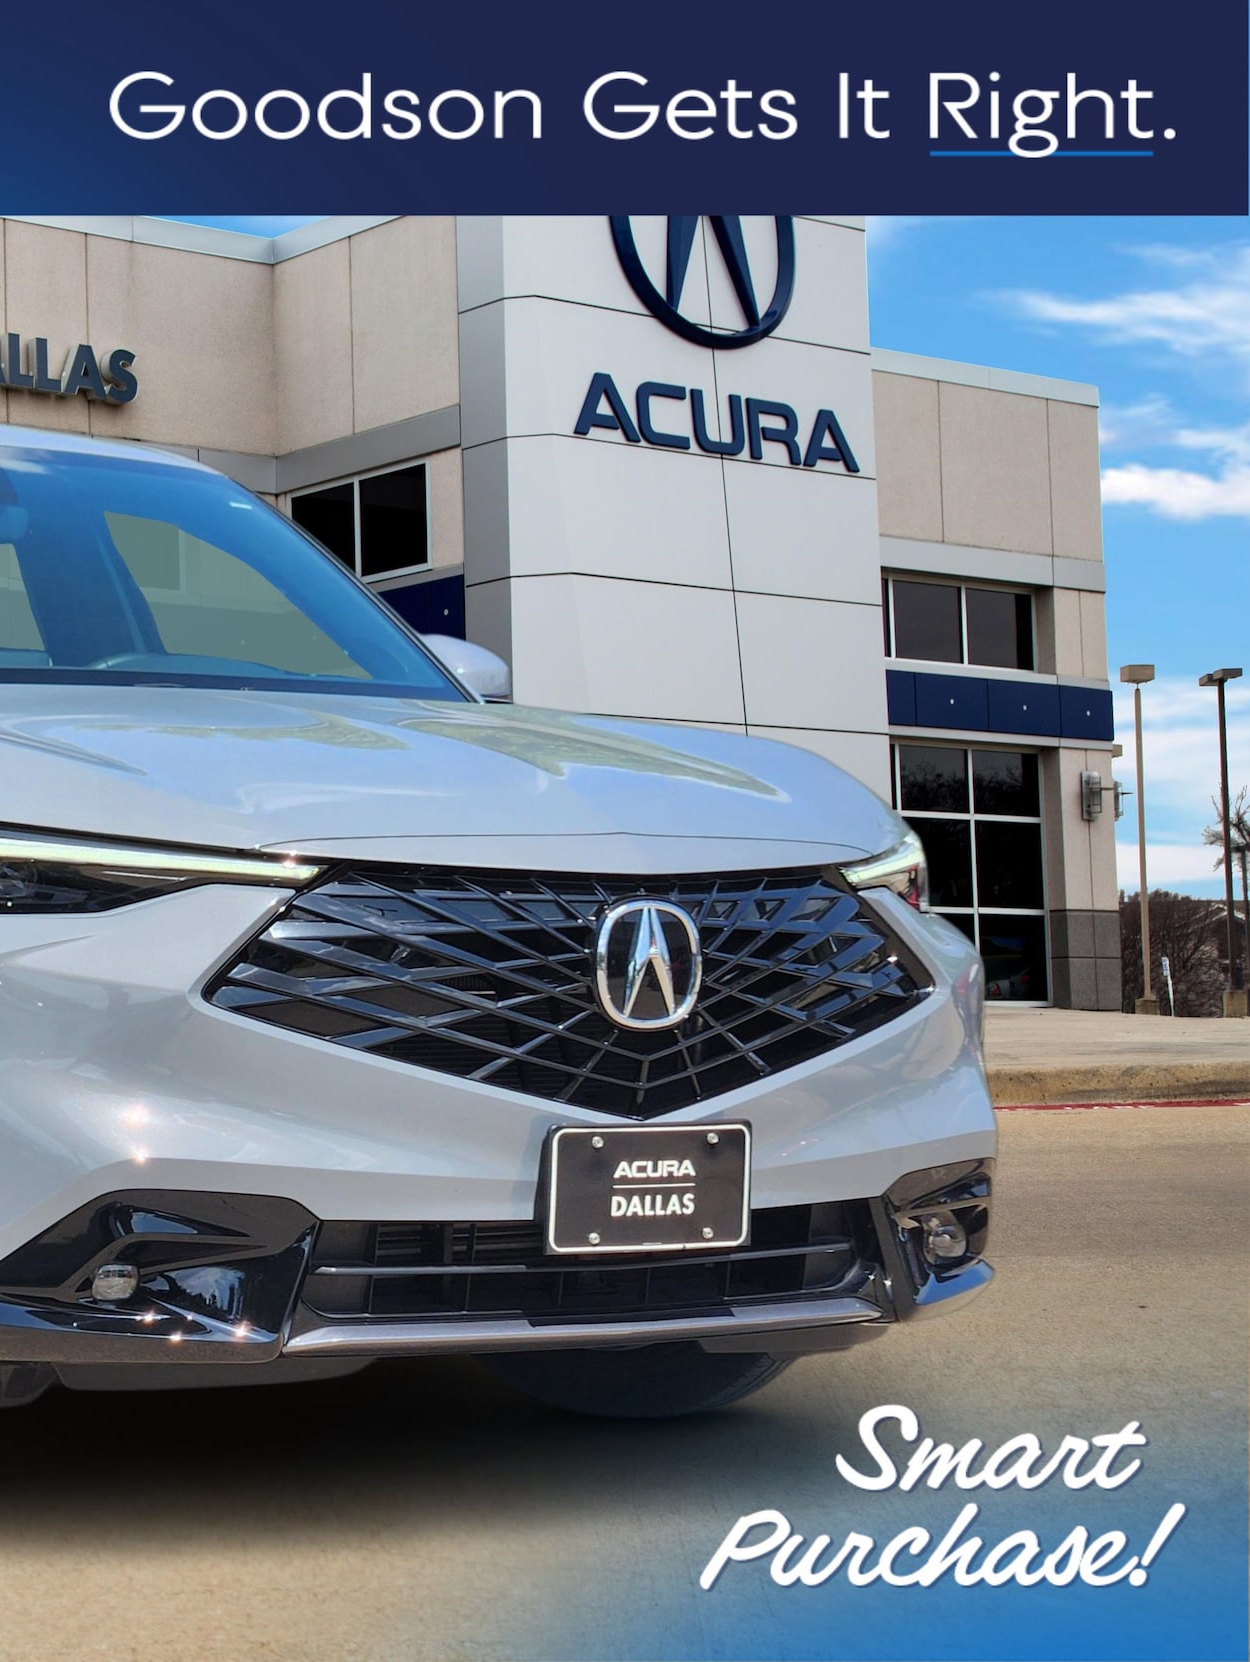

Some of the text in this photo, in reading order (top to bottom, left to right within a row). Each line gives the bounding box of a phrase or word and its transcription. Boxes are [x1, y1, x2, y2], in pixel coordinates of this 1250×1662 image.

[573, 372, 860, 473] ACURA
[613, 1159, 696, 1179] ACURA
[610, 1193, 695, 1217] DALLAS
